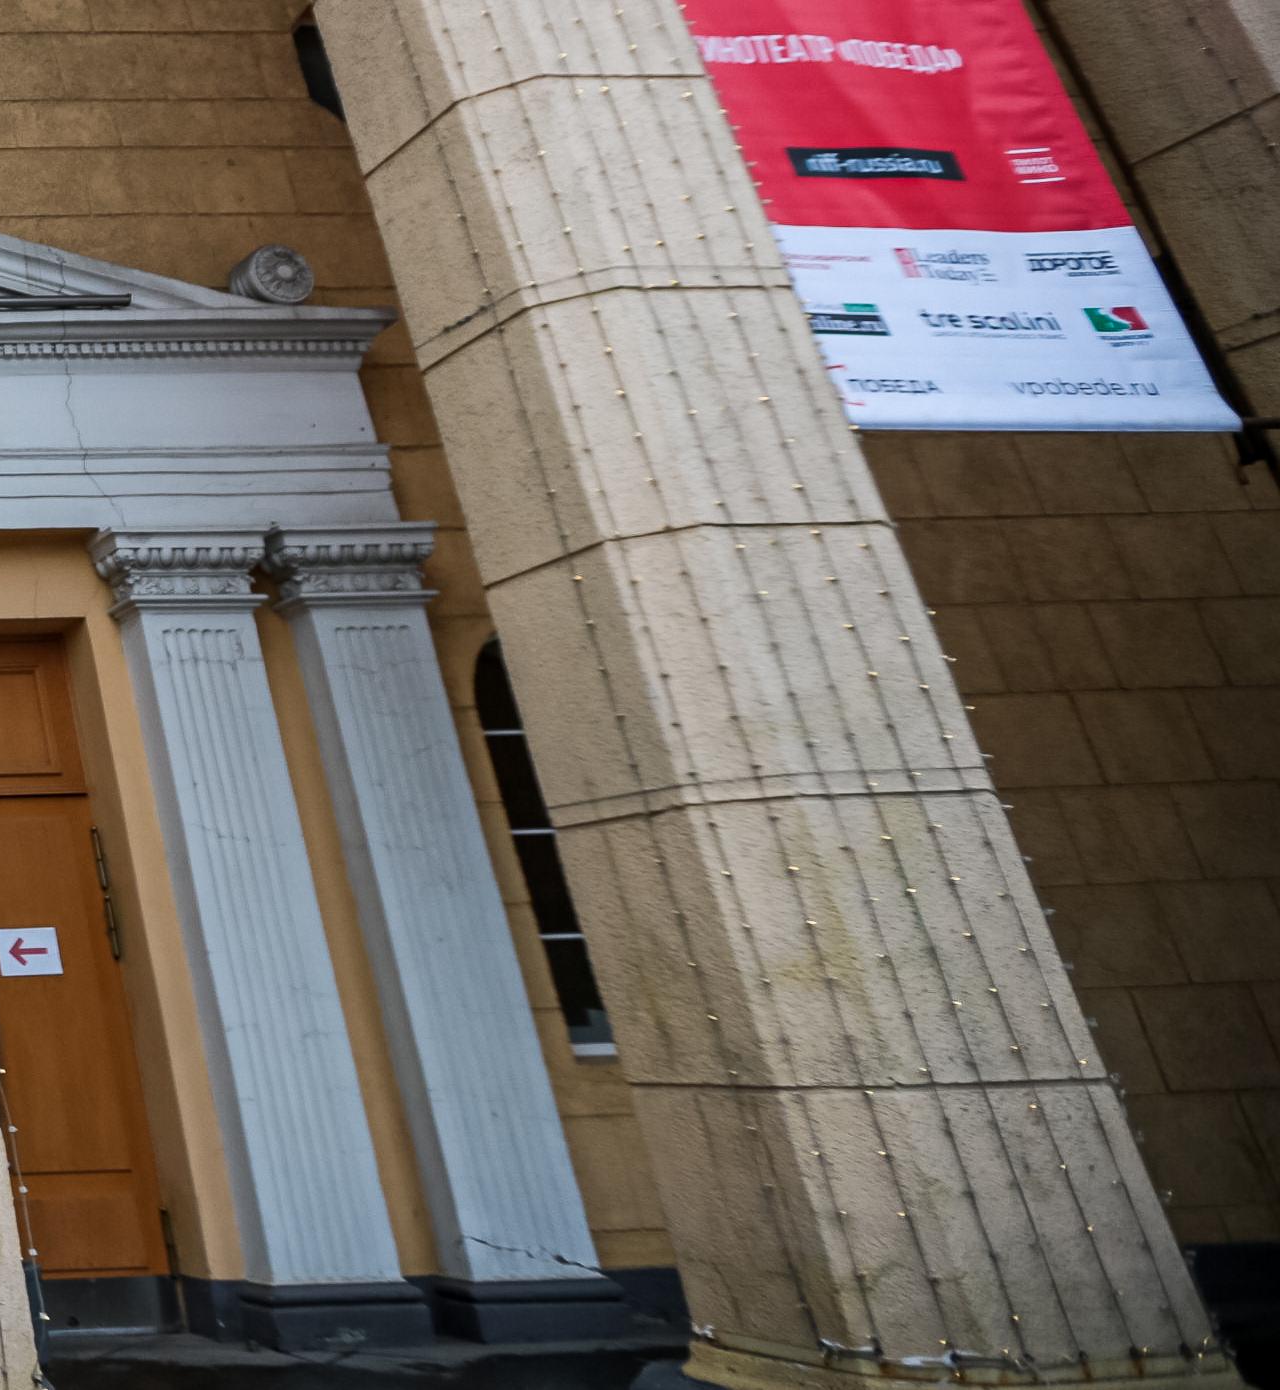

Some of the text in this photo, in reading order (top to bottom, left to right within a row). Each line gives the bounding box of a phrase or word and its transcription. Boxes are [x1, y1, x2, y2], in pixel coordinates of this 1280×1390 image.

[918, 309, 1062, 332] tre scolini
[846, 378, 943, 395] ПОБЕДА
[1008, 378, 1161, 397] vpobede.ru
